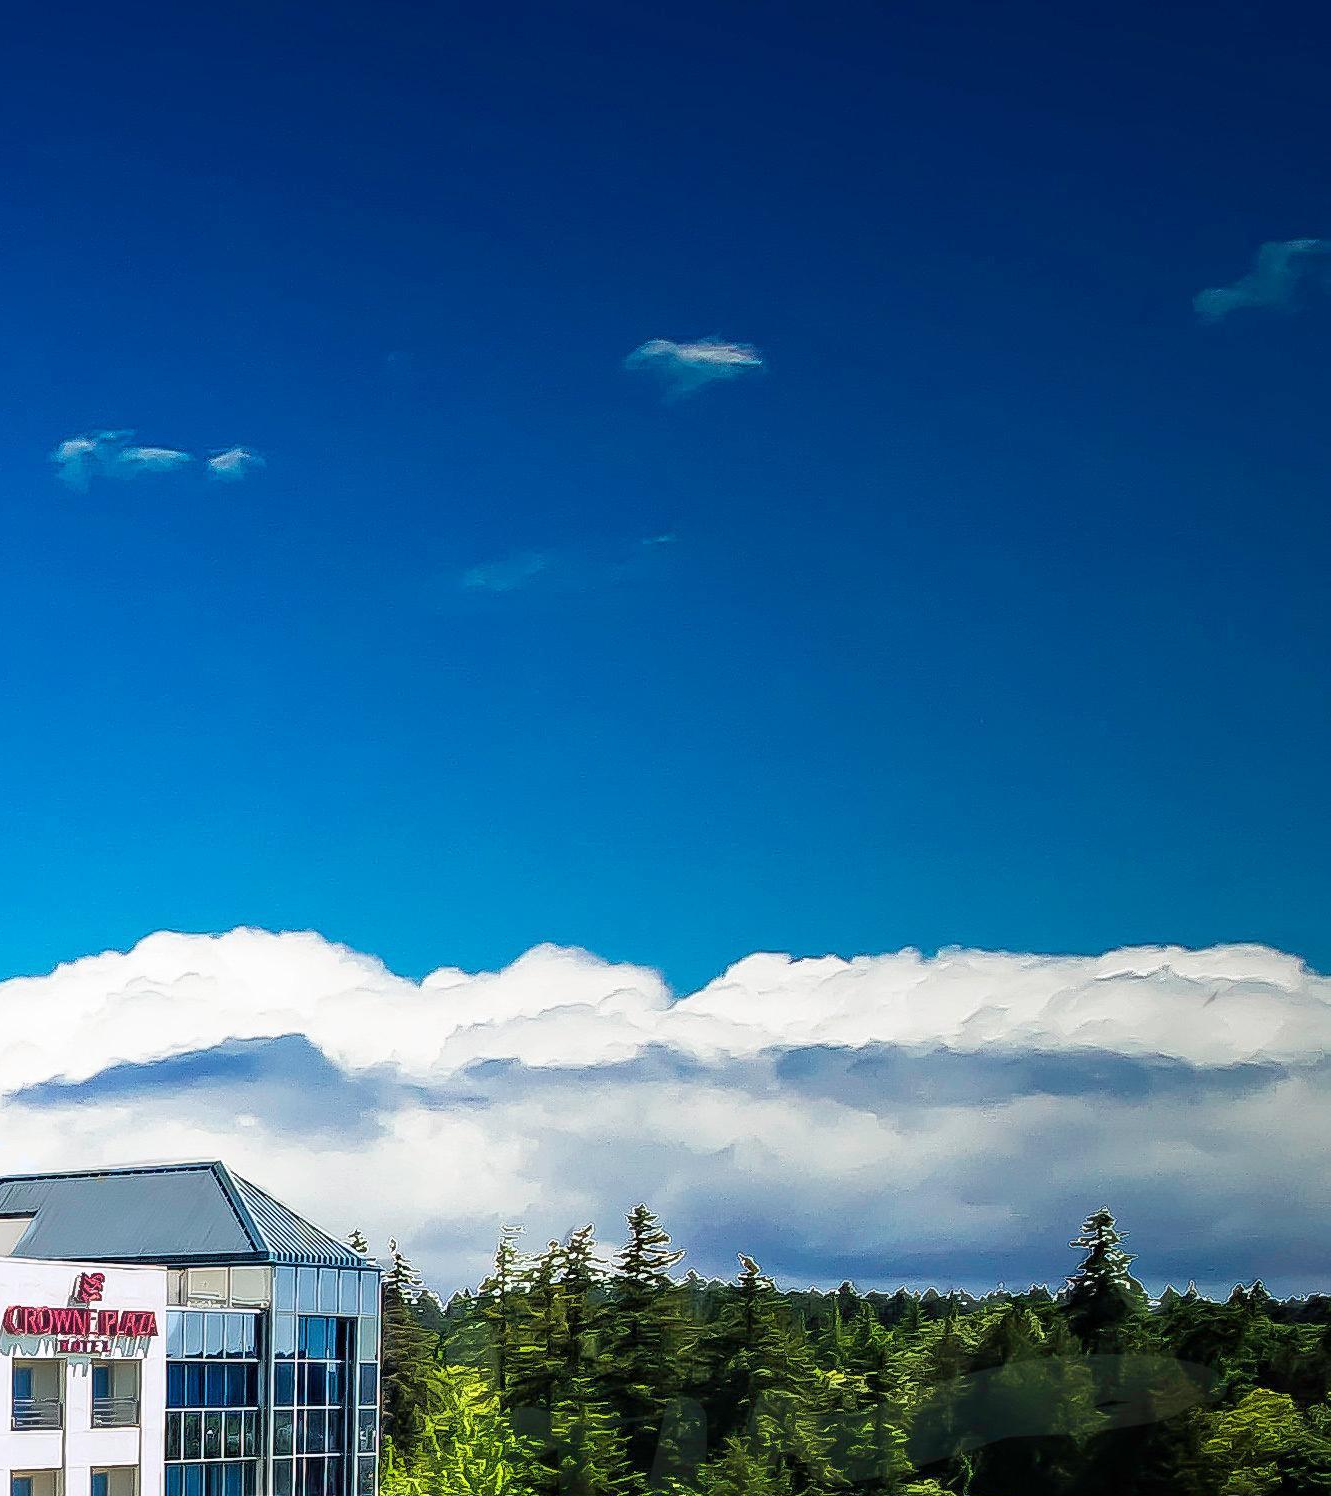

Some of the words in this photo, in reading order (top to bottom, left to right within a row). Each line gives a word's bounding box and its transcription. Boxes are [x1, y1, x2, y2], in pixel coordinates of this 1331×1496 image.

[2, 1305, 98, 1336] CROWNE
[99, 1309, 158, 1337] PLAZA
[57, 1339, 111, 1354] HOTEL
